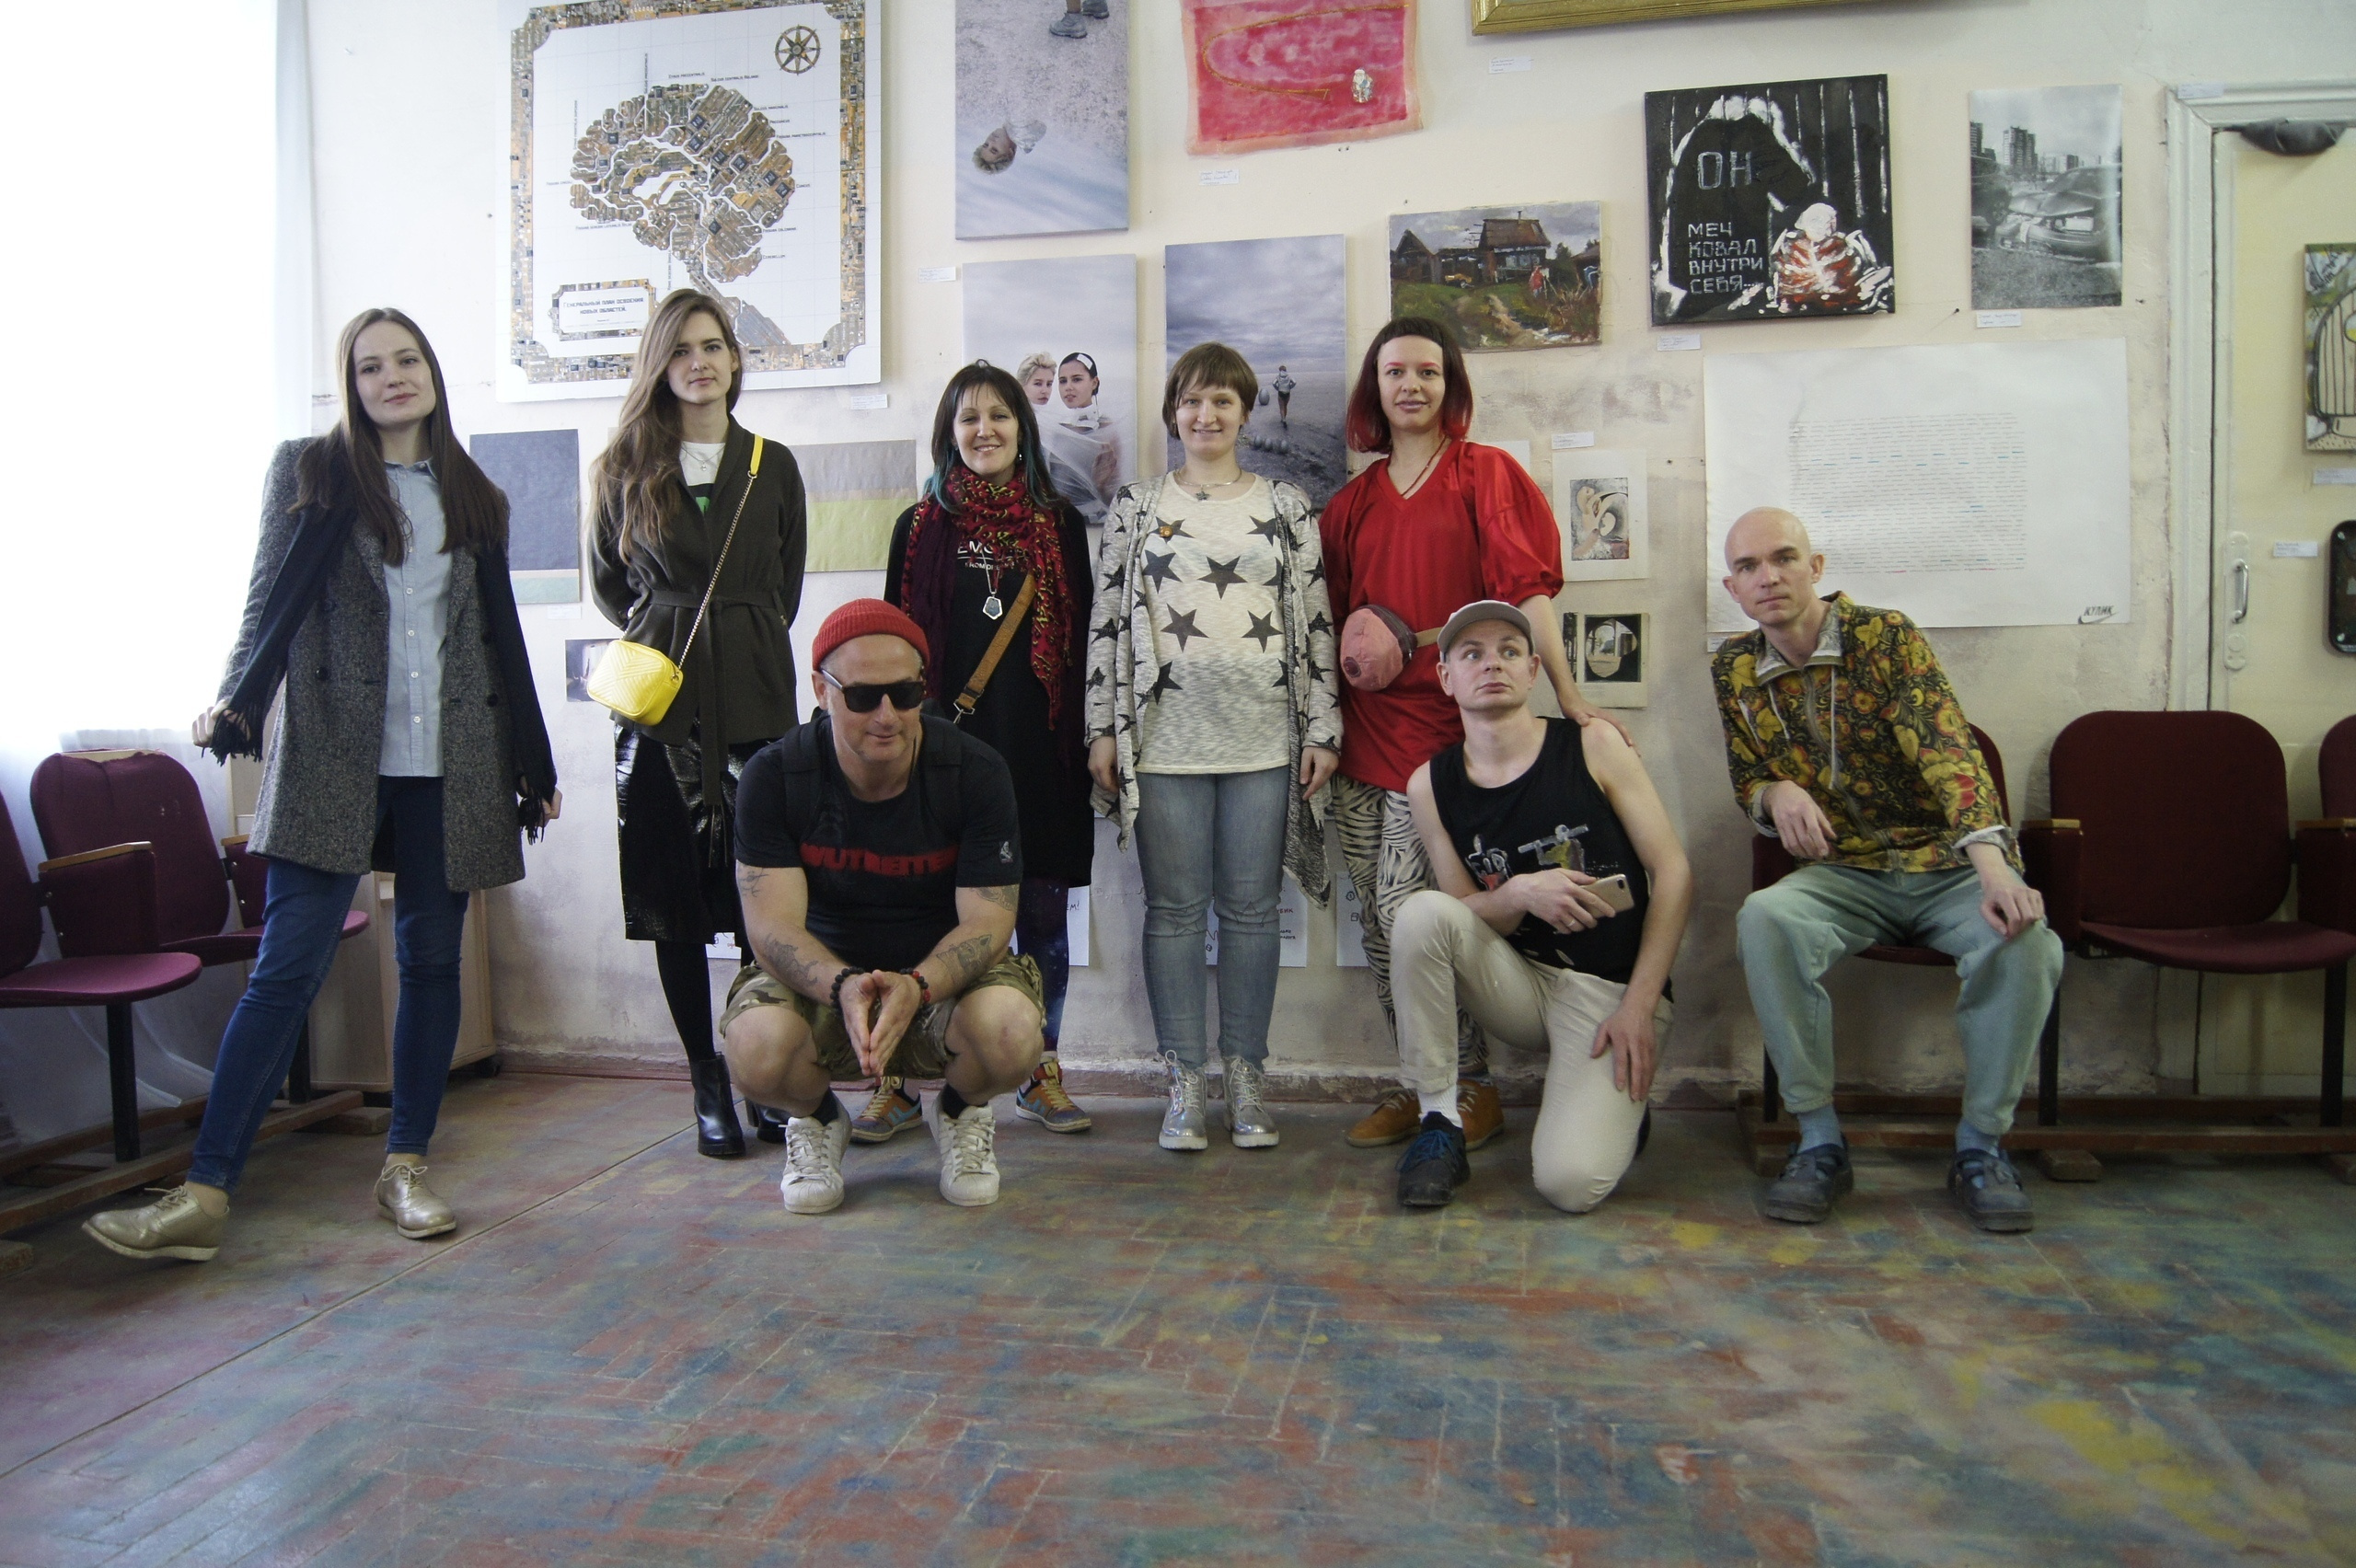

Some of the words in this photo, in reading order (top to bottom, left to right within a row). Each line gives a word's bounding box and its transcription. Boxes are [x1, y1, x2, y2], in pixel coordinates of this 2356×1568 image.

[1697, 150, 1752, 190] ОН
[1688, 222, 1732, 237] МЕЧ
[1689, 238, 1757, 258] КОВАЛ
[1689, 257, 1763, 275] ВНУТРИ
